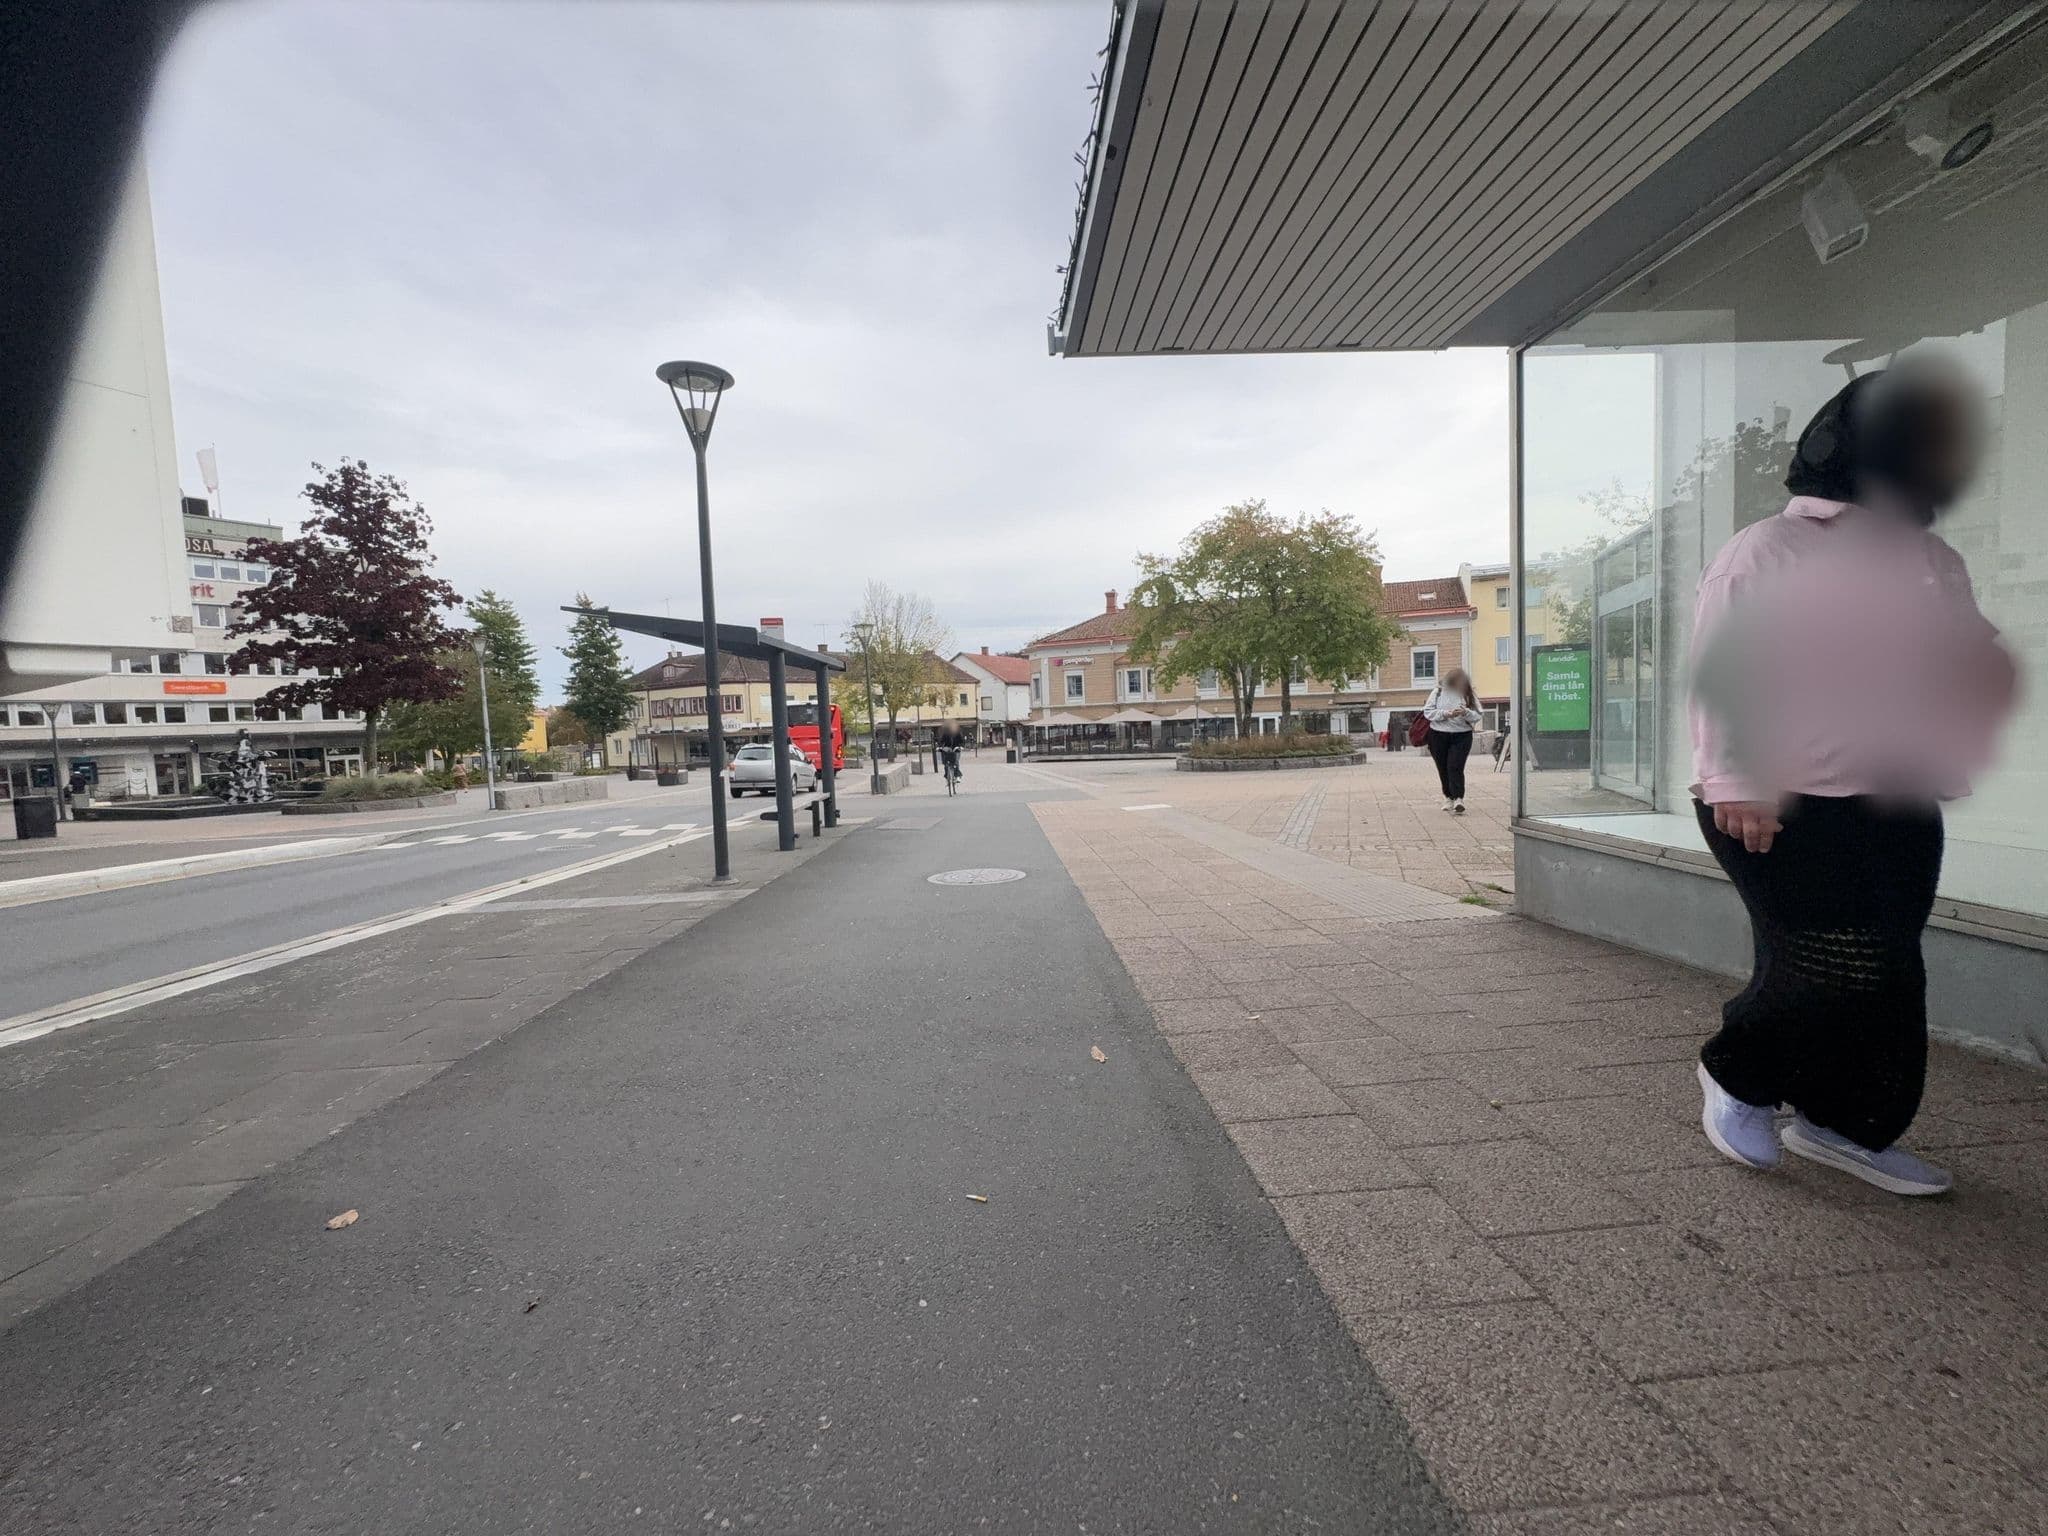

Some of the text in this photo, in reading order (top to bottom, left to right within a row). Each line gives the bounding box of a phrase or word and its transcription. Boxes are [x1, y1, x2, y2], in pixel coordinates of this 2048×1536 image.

[191, 583, 215, 598] rit
[1546, 671, 1580, 680] Samla
[1542, 681, 1585, 690] dina lån
[1554, 692, 1581, 701] höst.
